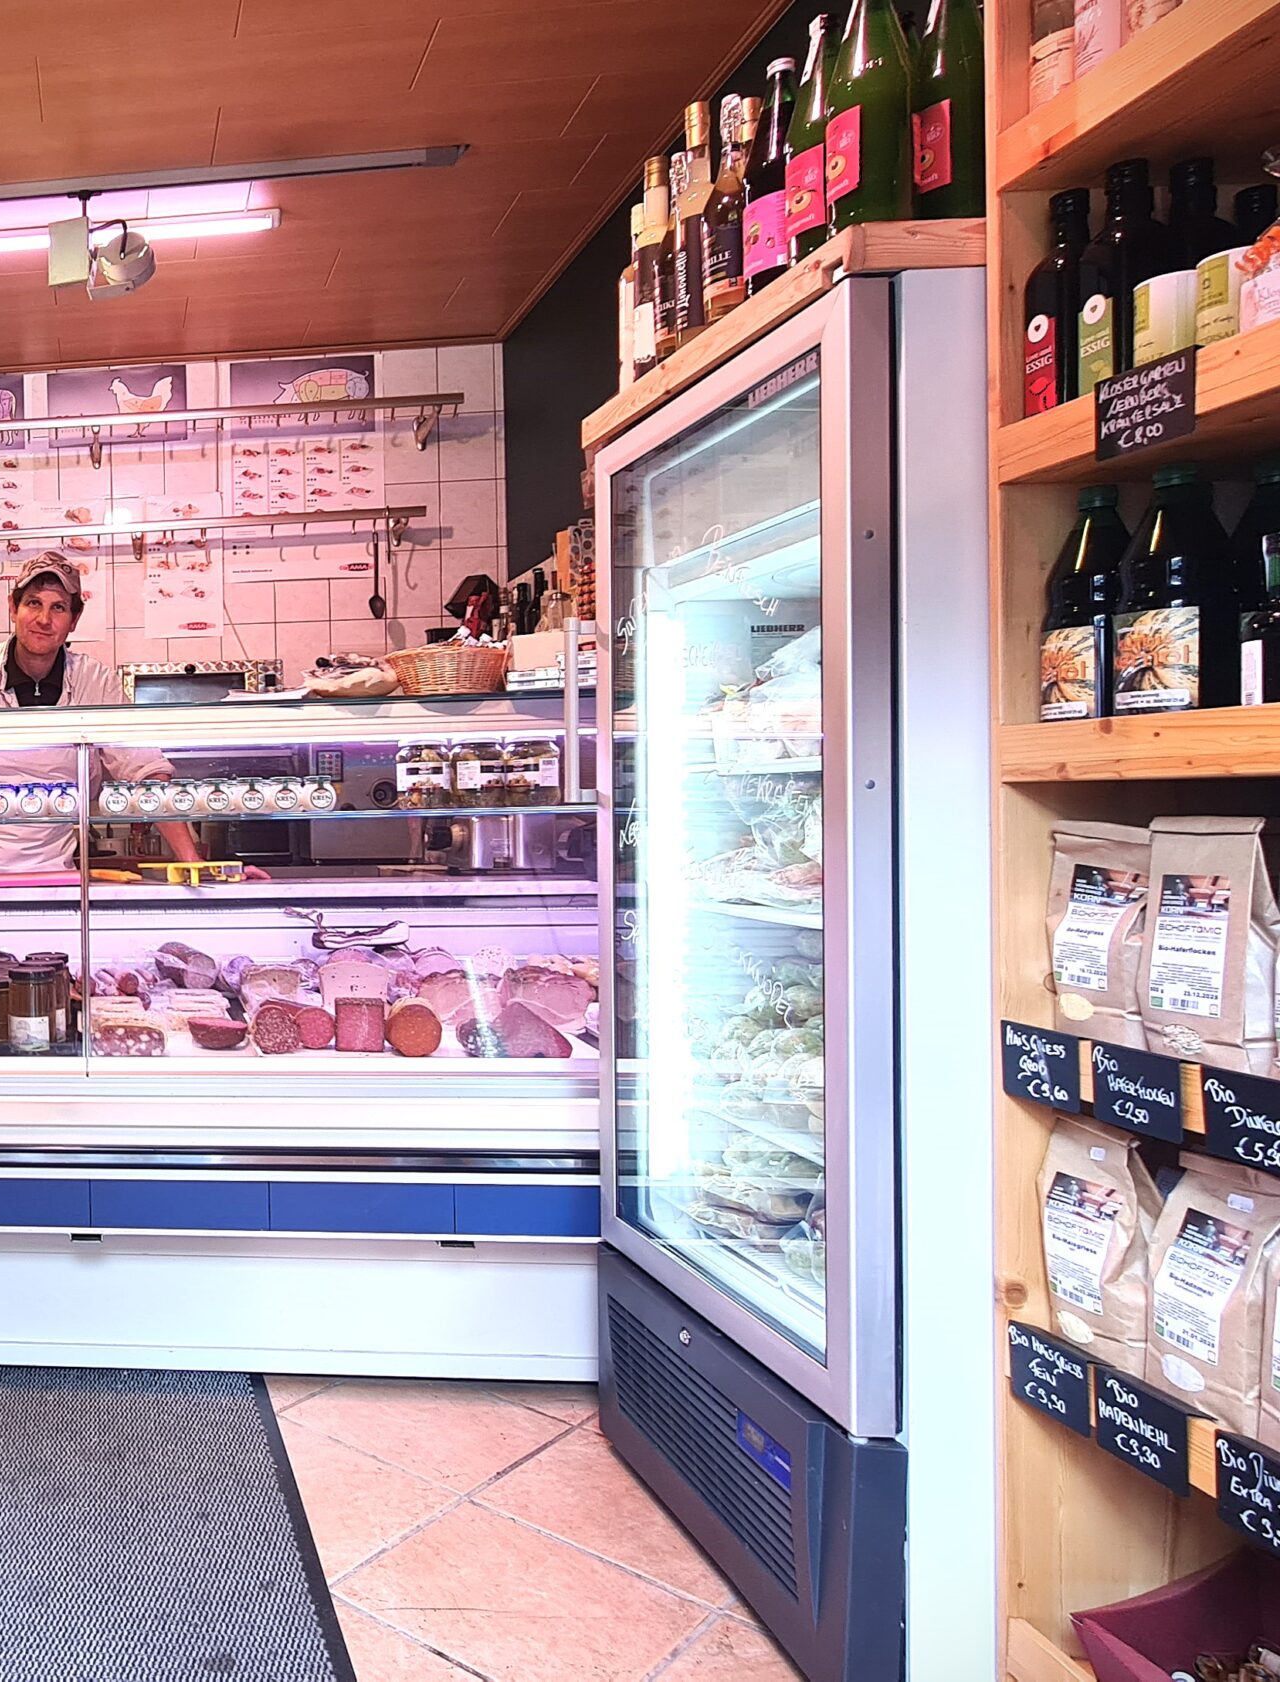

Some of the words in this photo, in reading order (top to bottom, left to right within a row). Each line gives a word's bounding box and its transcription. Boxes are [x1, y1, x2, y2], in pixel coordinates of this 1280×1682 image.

[706, 250, 733, 267] RILLE
[1081, 336, 1111, 358] ESSIG
[1026, 354, 1053, 375] ESSIG
[748, 350, 820, 408] LIEBHERR
[1118, 423, 1163, 449] €8,00
[187, 622, 207, 630] AMA
[751, 624, 805, 633] LIEBHERR
[1073, 892, 1101, 905] KORN
[1114, 1433, 1161, 1469] €3,30
